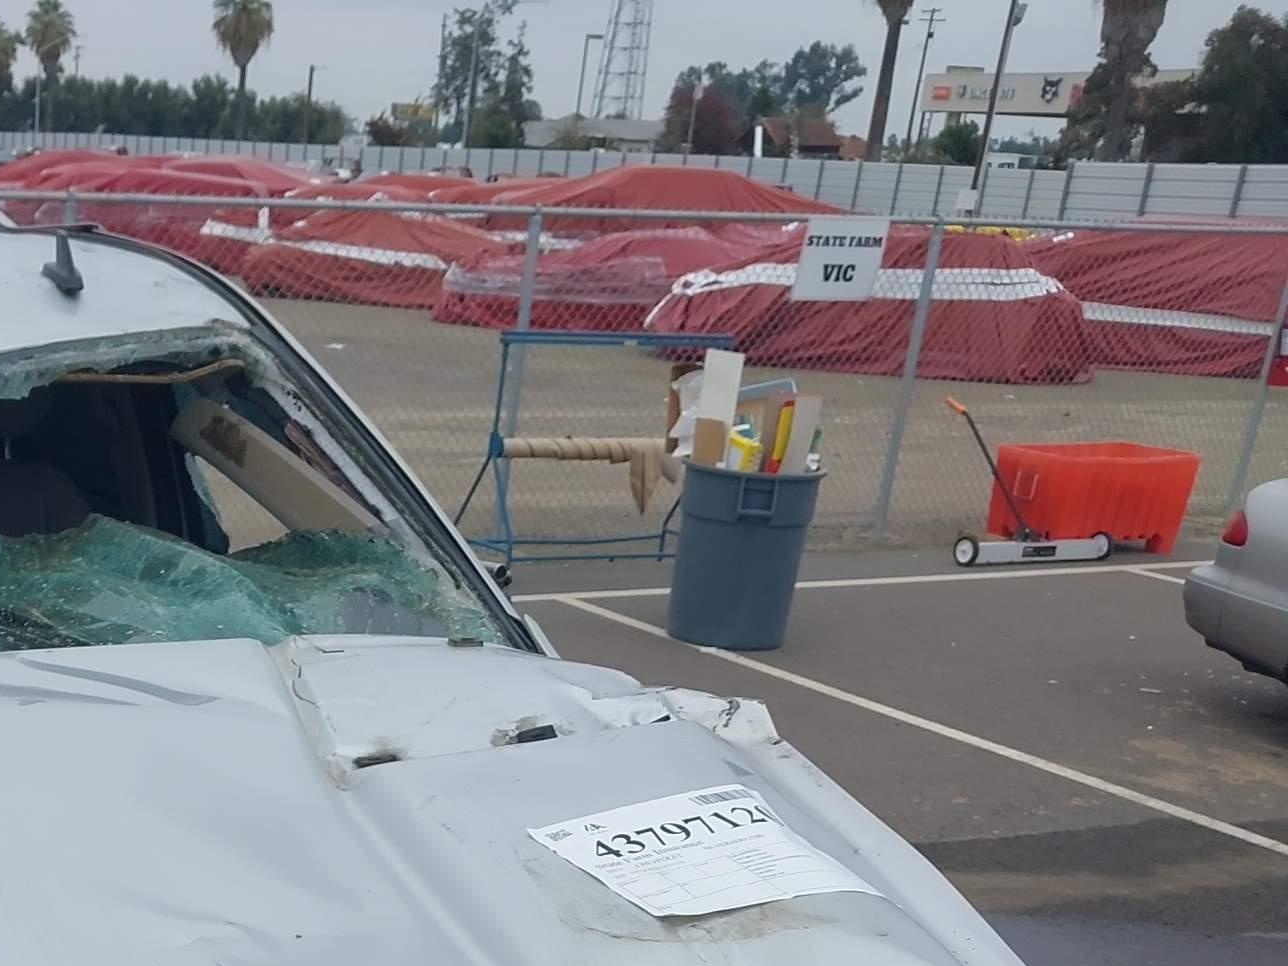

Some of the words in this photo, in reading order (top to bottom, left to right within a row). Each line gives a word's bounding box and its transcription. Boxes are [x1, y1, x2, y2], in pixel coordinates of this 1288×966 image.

[807, 235, 847, 248] STATE
[848, 235, 883, 248] FARM
[822, 264, 856, 282] VIC
